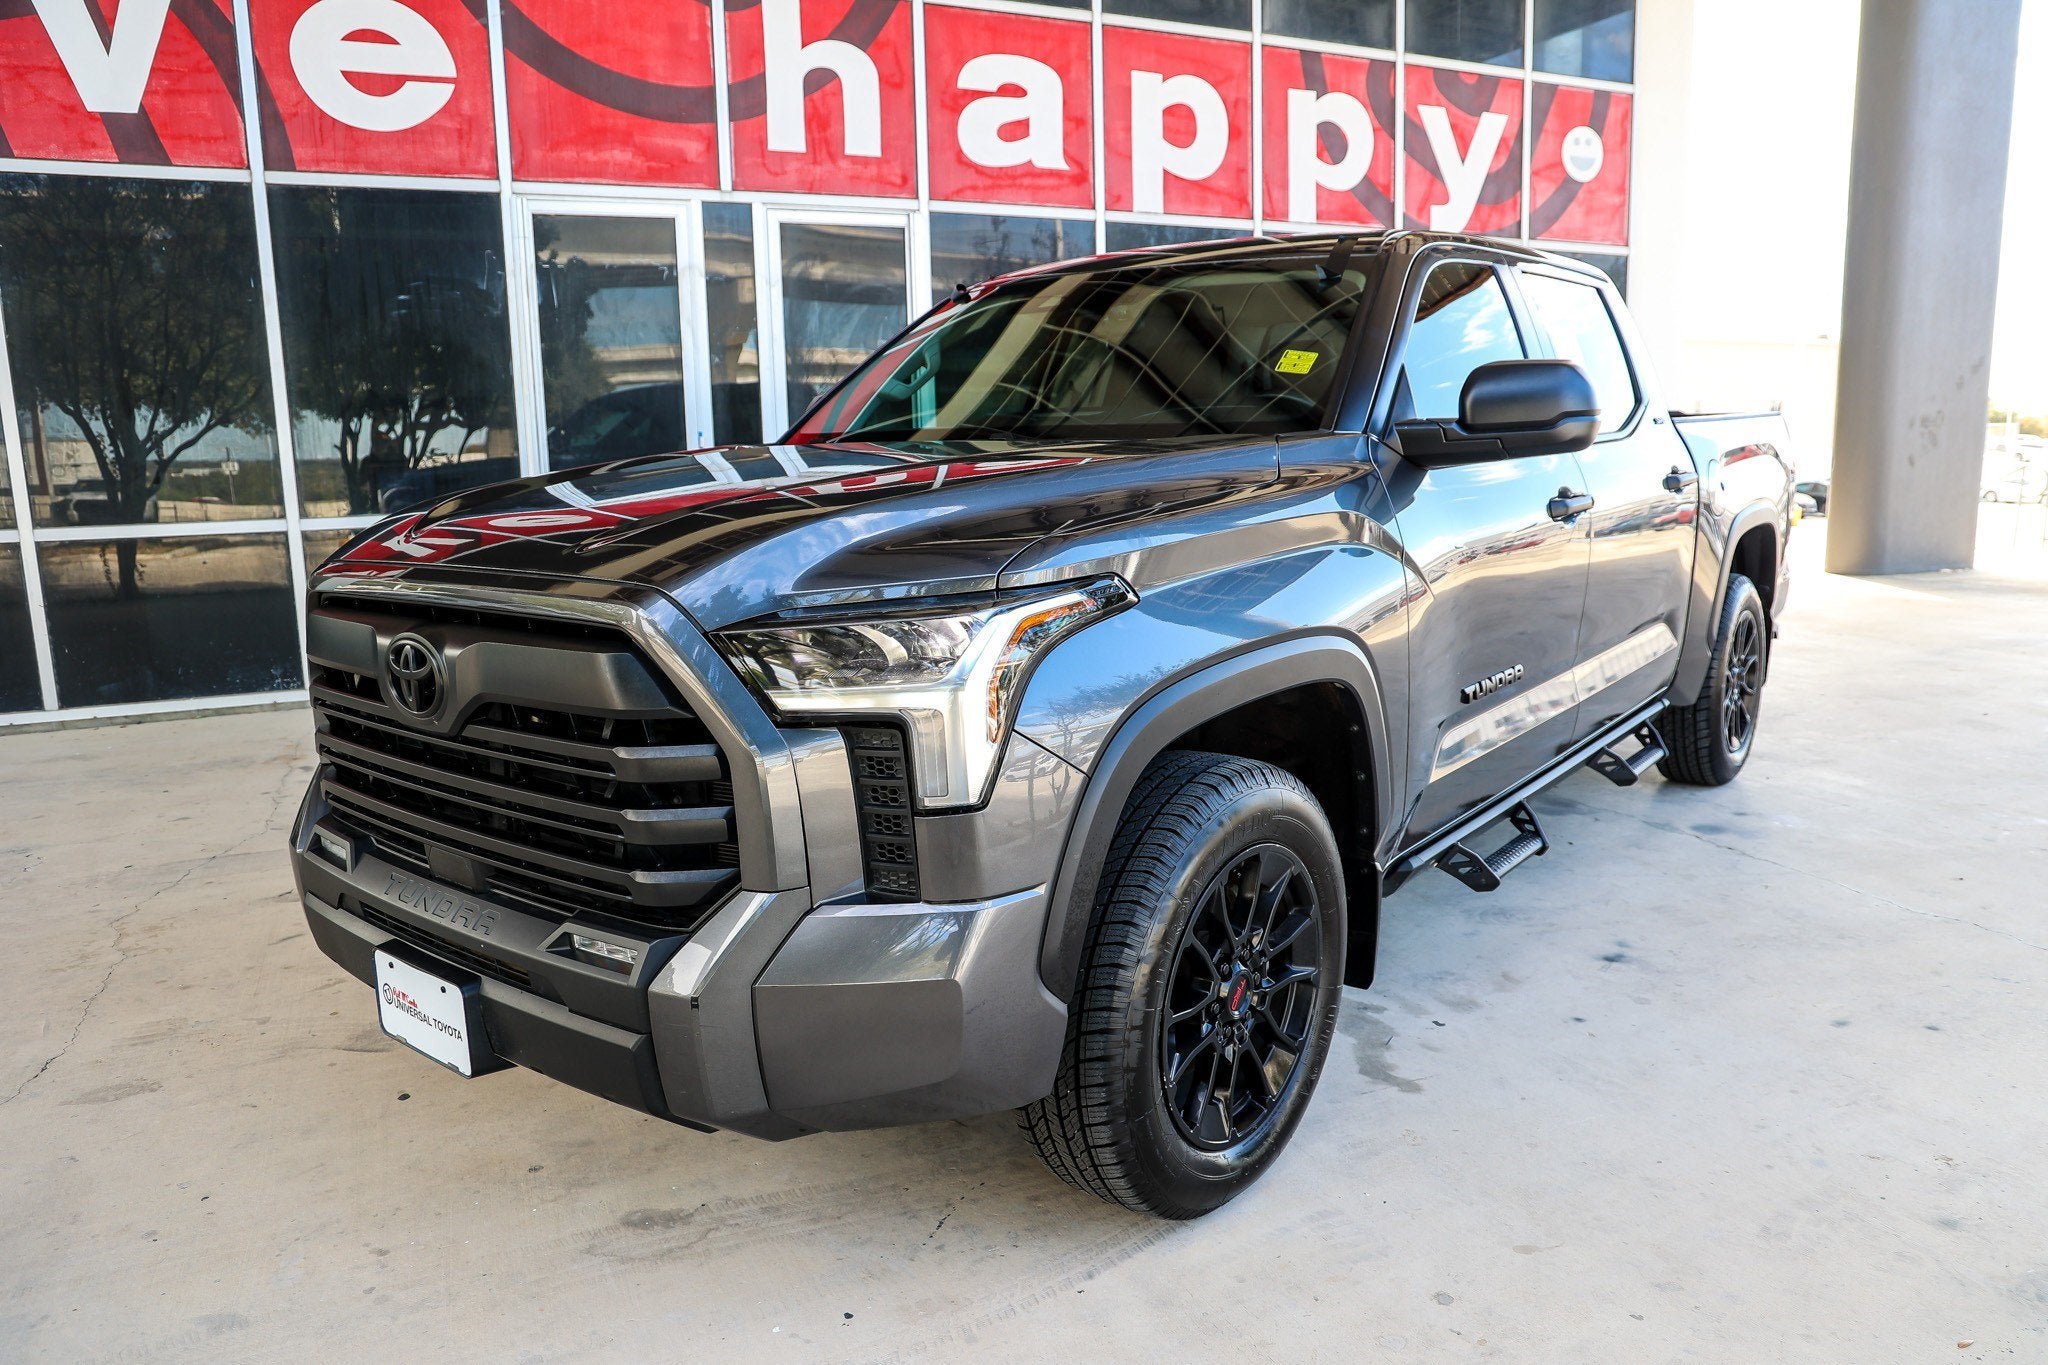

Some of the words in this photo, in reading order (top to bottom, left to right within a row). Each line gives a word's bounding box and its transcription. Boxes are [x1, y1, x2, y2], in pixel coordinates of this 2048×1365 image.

[763, 0, 1509, 233] happy
[1460, 664, 1524, 704] TUNDRA
[384, 872, 500, 936] TUNDRA
[394, 998, 433, 1027] UNIVERSAL
[432, 1018, 463, 1042] TOYOTA
